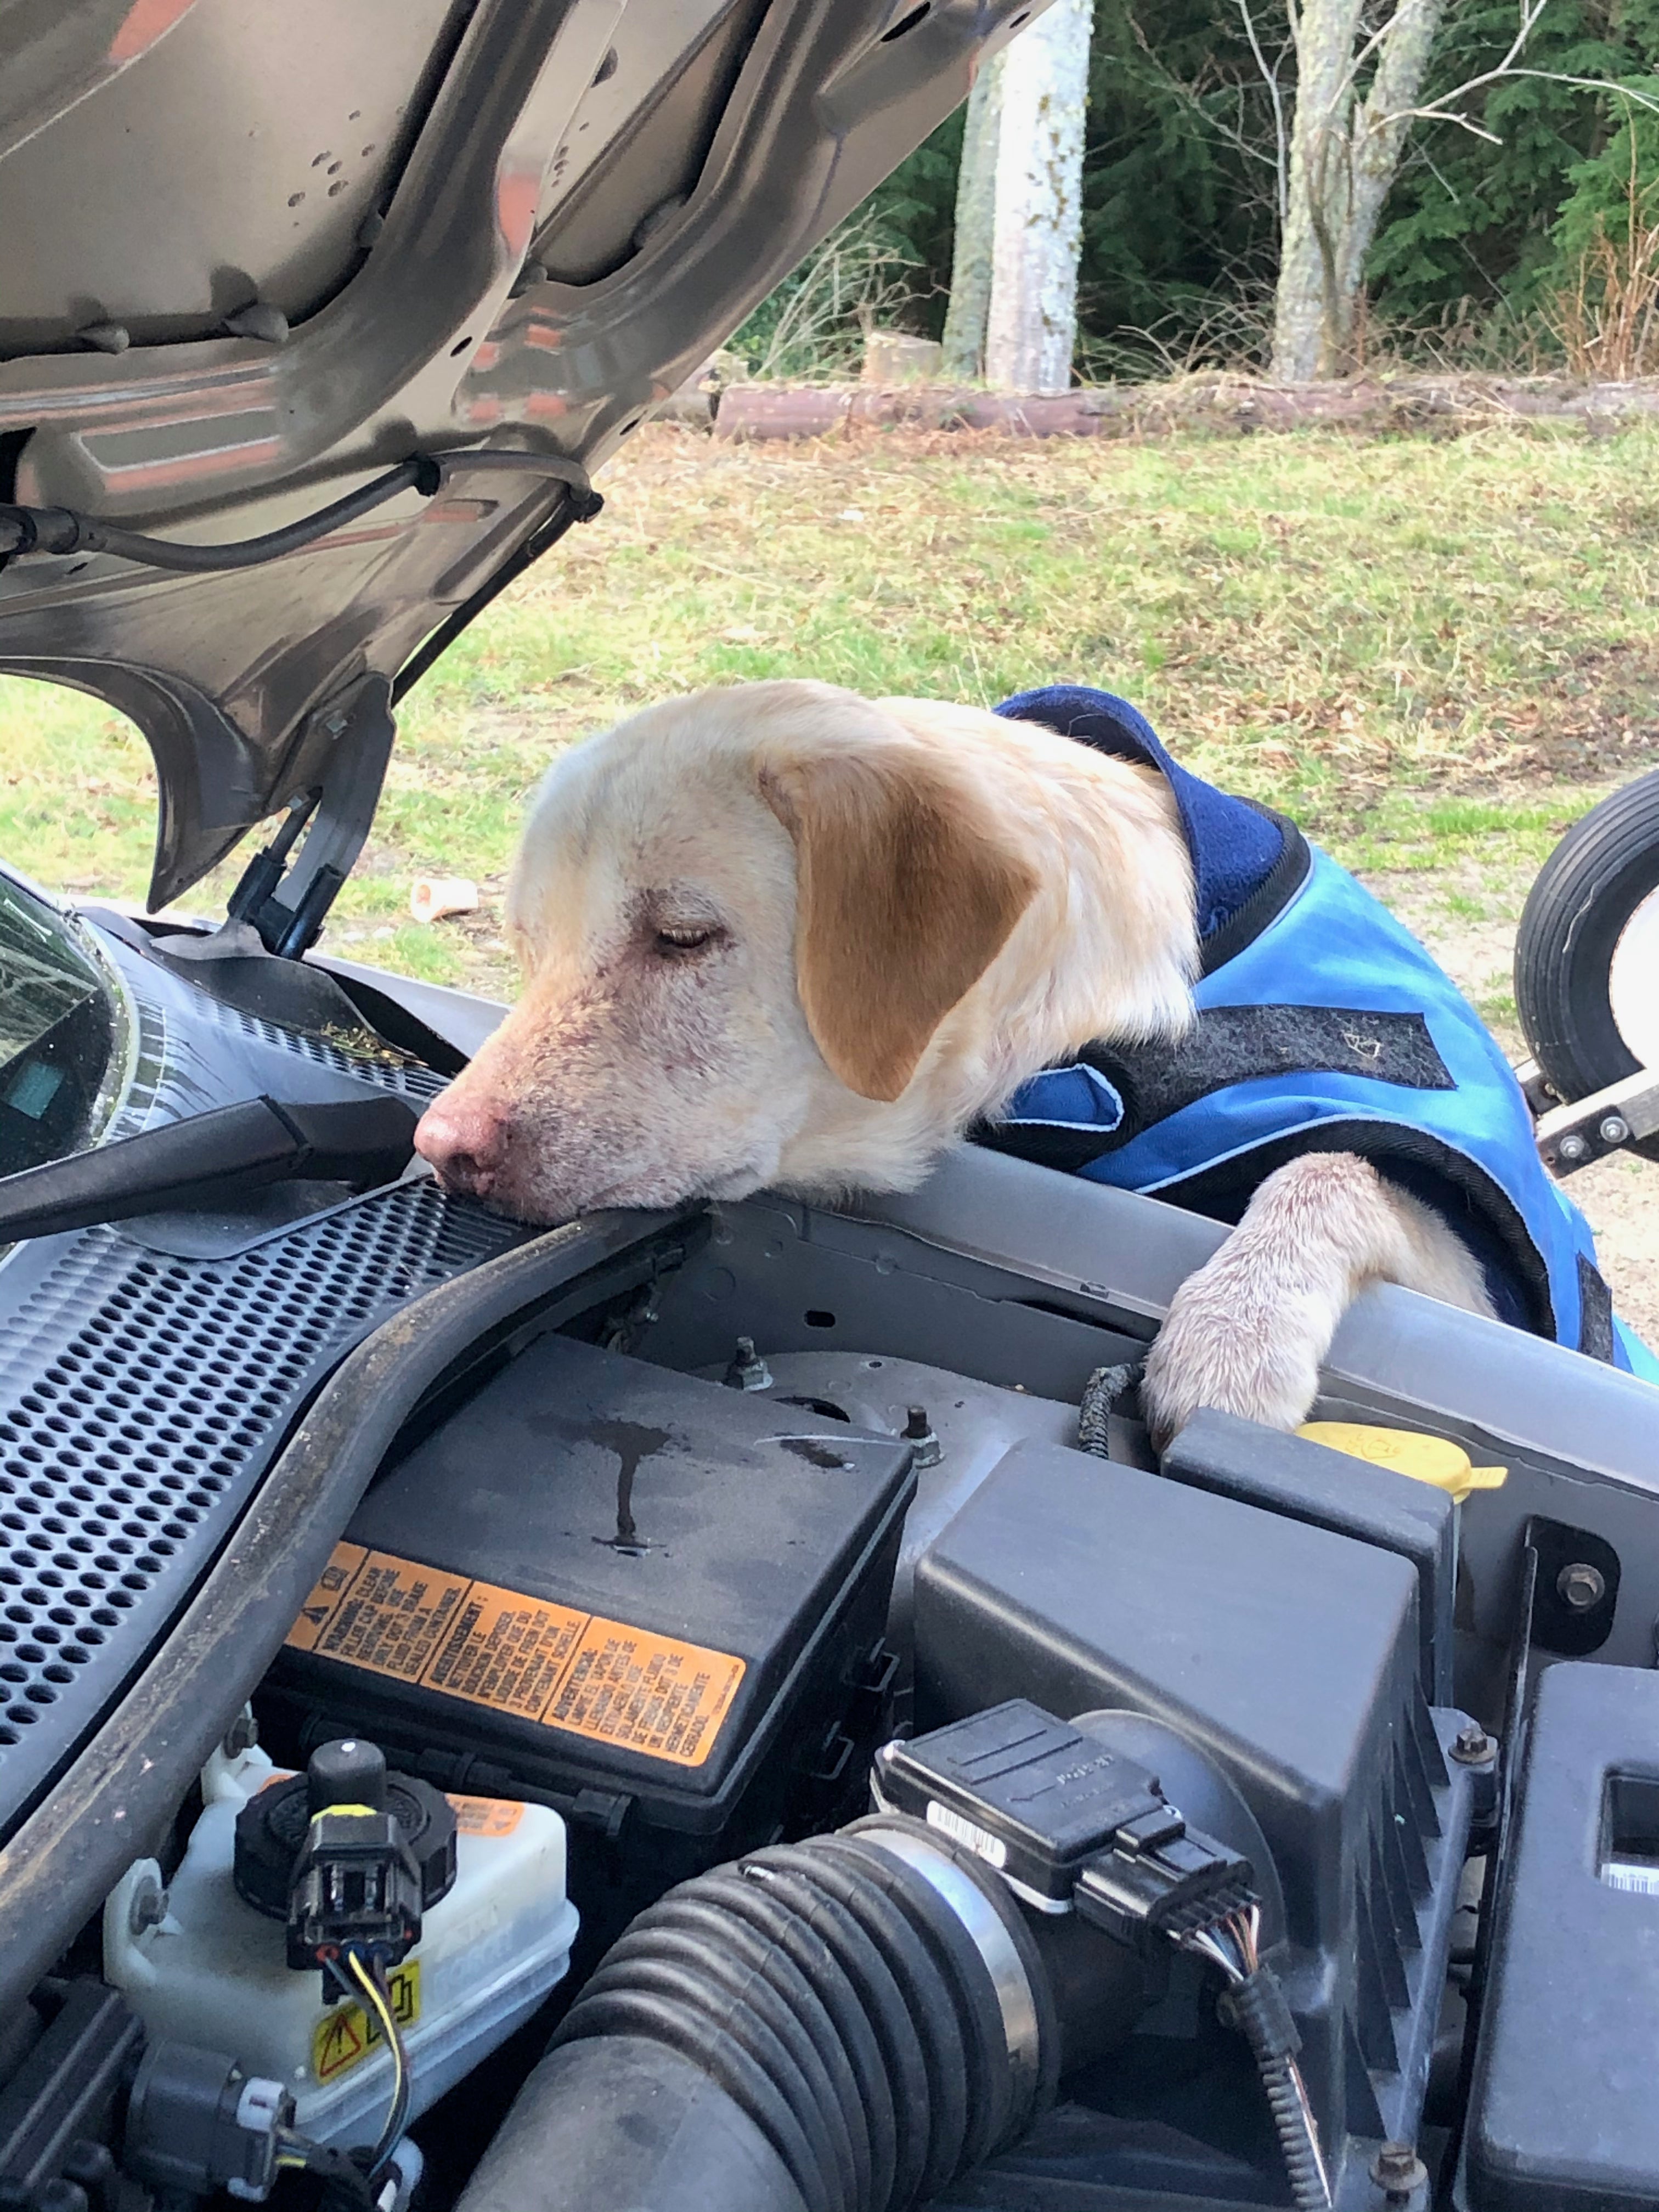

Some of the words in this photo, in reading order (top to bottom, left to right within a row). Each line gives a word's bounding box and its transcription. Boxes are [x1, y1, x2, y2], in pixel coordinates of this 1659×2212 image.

[323, 1599, 364, 1651] WARNING:
[357, 1567, 382, 1597] CLEAN
[339, 1624, 367, 1657] FILLER
[358, 1604, 379, 1624] CAP
[370, 1568, 400, 1605] BEFORE
[385, 1588, 406, 1607] USE
[515, 1611, 532, 1624] DU
[531, 1609, 549, 1628] DOT
[371, 1641, 394, 1666] ONLY
[385, 1621, 404, 1641] DOT
[400, 1581, 428, 1613] BRAKE
[386, 1643, 411, 1671] FLUID
[402, 1615, 427, 1643] FROM
[430, 1601, 483, 1684] AVERTISSEMENT
[506, 1624, 526, 1643] QUE
[518, 1628, 540, 1655] FREIN
[605, 1638, 620, 1652] DE
[402, 1639, 431, 1675] SEALED
[445, 1644, 479, 1689] NETTOYER
[469, 1630, 487, 1644] LE
[460, 1651, 493, 1695] BOUCHON
[510, 1655, 527, 1668] DE
[512, 1647, 546, 1700] PROVENANT
[590, 1653, 613, 1680] TAPON
[607, 1655, 630, 1683] ANTES
[620, 1639, 637, 1654] DE
[492, 1668, 520, 1704] LIQUIDE
[524, 1660, 559, 1713] CONTENANT
[583, 1682, 600, 1695] EL
[631, 1730, 648, 1745] DE
[654, 1675, 674, 1695] DOT
[667, 1653, 684, 1667] DE
[569, 1694, 592, 1725] LIMPIE
[615, 1685, 652, 1740] SOLAMENTE
[648, 1734, 663, 1748] UN
[656, 1684, 687, 1734] RECIPIENTE
